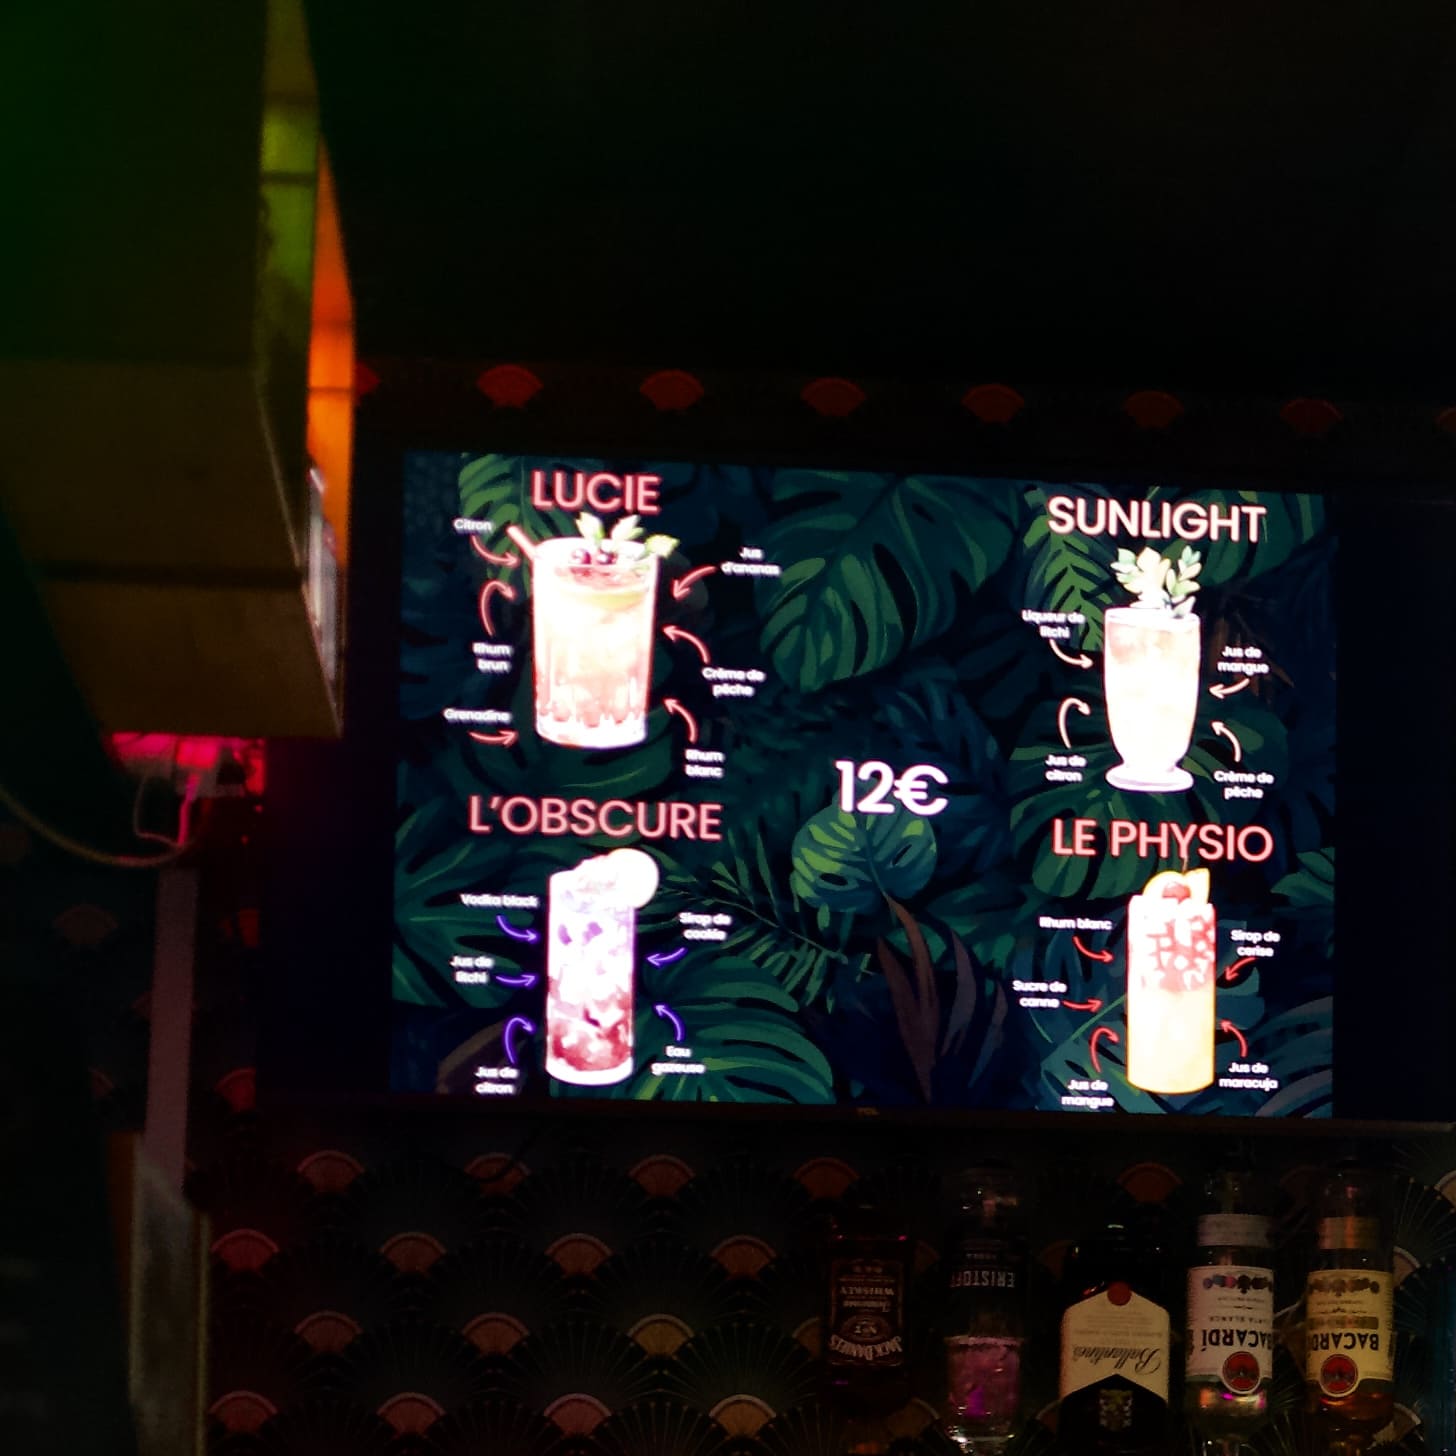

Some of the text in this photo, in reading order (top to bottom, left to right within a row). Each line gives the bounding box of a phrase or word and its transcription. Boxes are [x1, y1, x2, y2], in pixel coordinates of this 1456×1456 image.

[532, 471, 660, 514] LUCIE
[1048, 496, 1266, 542] SUNLIGHT
[454, 518, 493, 533] Citron
[740, 548, 762, 559] Jus
[721, 562, 780, 575] d'ananas
[1022, 610, 1086, 624] Liqueur de
[473, 643, 512, 655] Rhum
[1222, 646, 1262, 658] Jus de
[478, 659, 510, 671] brun
[1218, 662, 1269, 675] mangue
[744, 670, 765, 681] de
[444, 708, 511, 723] Grenadine
[686, 749, 724, 761] Rhum
[1045, 755, 1086, 767] Jus de
[686, 765, 722, 777] blanc
[1046, 769, 1082, 781] citron
[1254, 772, 1274, 784] de
[836, 760, 948, 815] 12€
[470, 796, 721, 840] L'OBSCURE
[1053, 819, 1273, 862] LE PHYSIO
[461, 894, 538, 907] Vodka black
[679, 912, 731, 927] Sirop de
[1040, 917, 1112, 930] Rhum blanc
[684, 926, 726, 940] cookie
[1231, 930, 1280, 944] Sirop de
[1237, 946, 1274, 956] cerise
[450, 956, 494, 968] Jus de
[1013, 980, 1067, 992] Sucre de
[1020, 998, 1059, 1008] canne
[666, 1046, 691, 1057] Eau
[475, 1067, 518, 1078] Jus de
[651, 1063, 706, 1076] gazeuse
[1229, 1063, 1268, 1073] Jus de
[476, 1082, 514, 1094] citron
[1067, 1080, 1108, 1091] Jus de
[1219, 1078, 1278, 1091] maracuja
[1061, 1096, 1114, 1109] mangue
